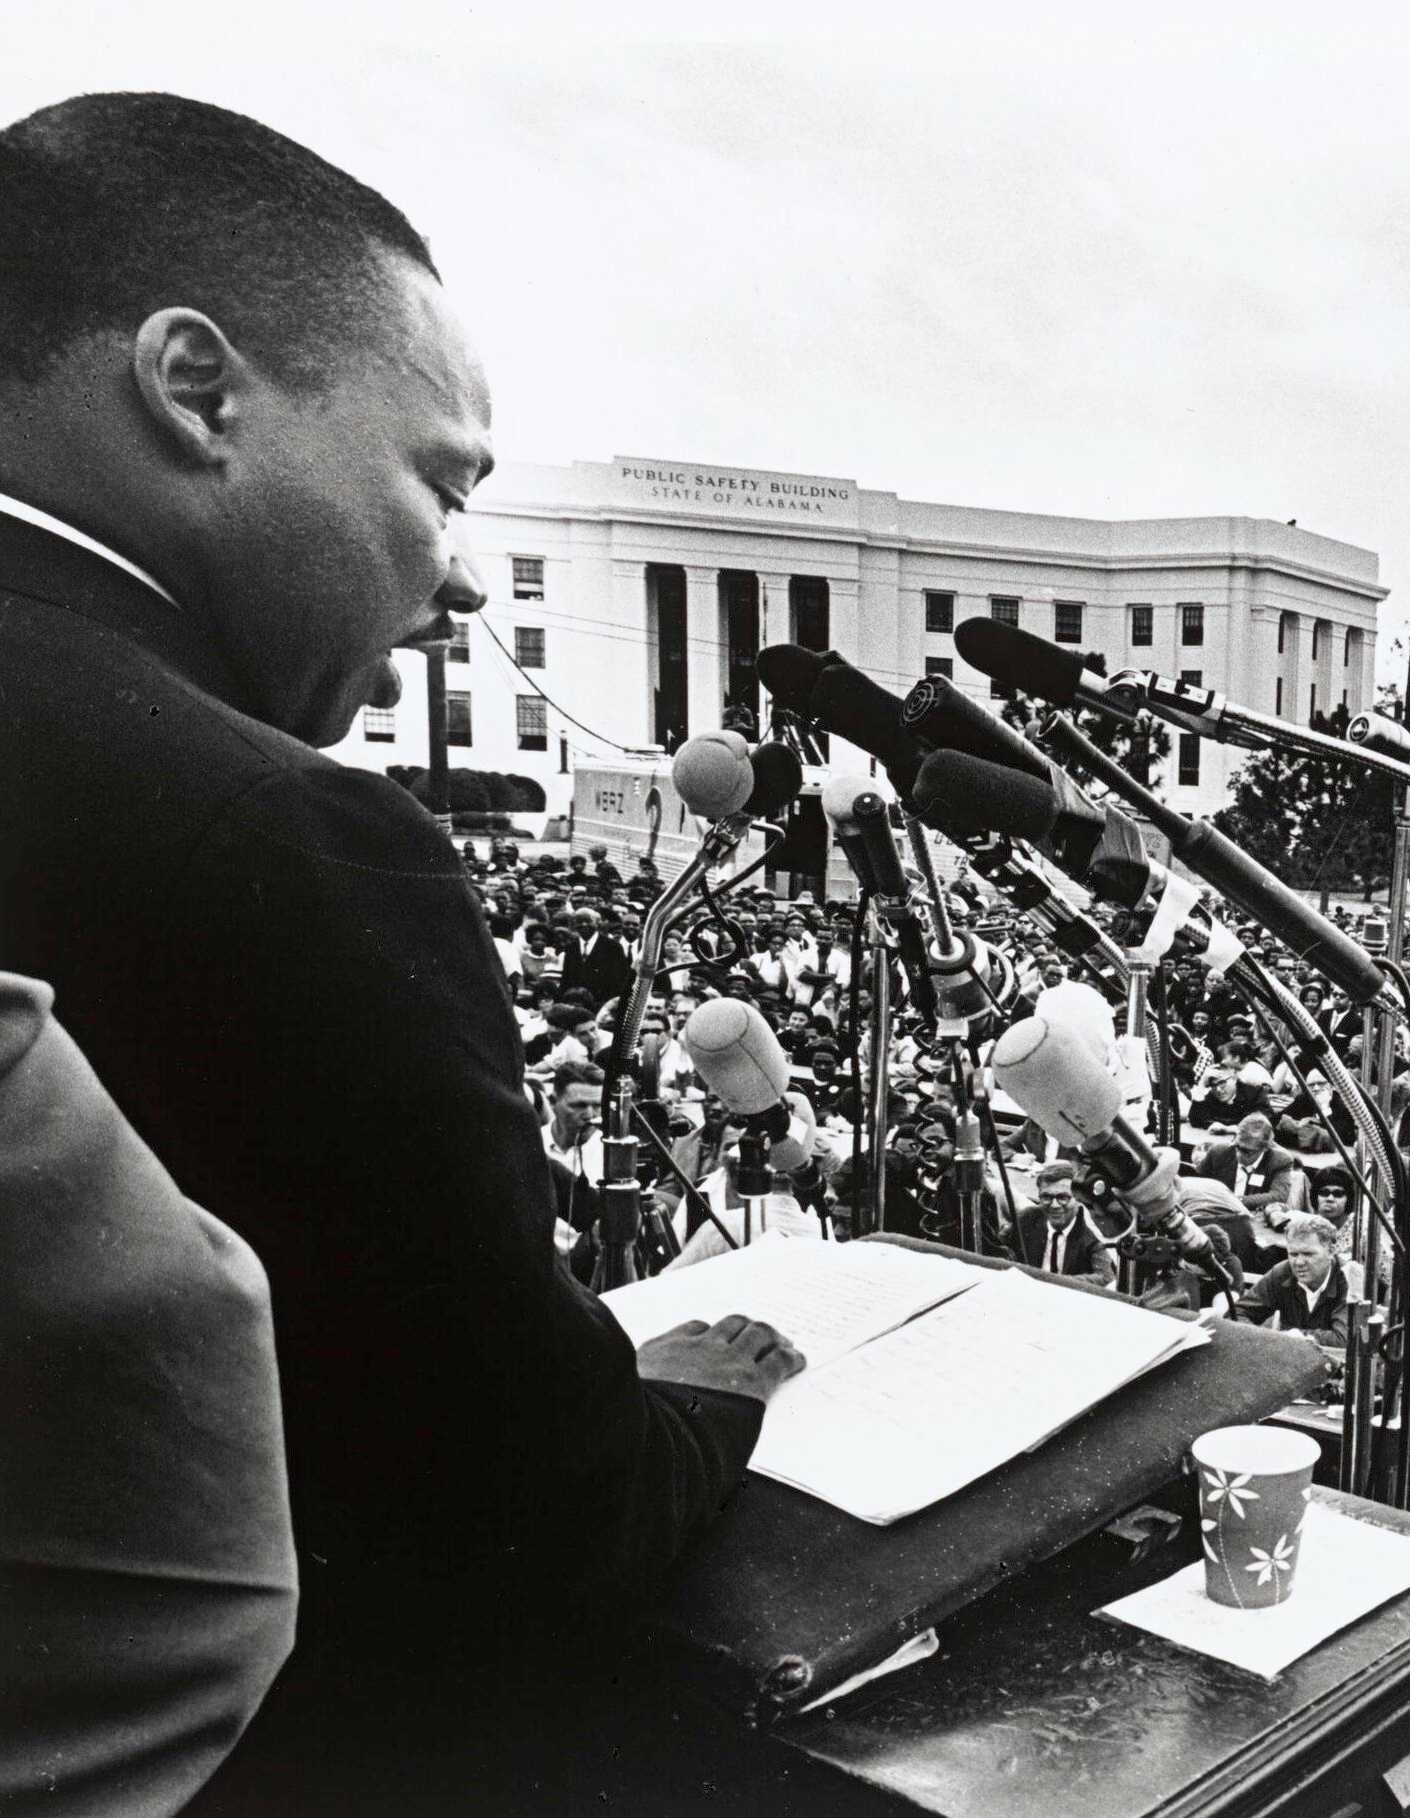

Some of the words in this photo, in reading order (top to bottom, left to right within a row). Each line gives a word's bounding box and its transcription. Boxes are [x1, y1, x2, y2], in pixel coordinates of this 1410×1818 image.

[621, 467, 685, 484] PUBLIC
[695, 474, 760, 491] SAFETY
[770, 482, 849, 500] BUILDING
[651, 486, 701, 500] STATE
[713, 492, 732, 503] OF
[746, 496, 823, 513] ALABAMA
